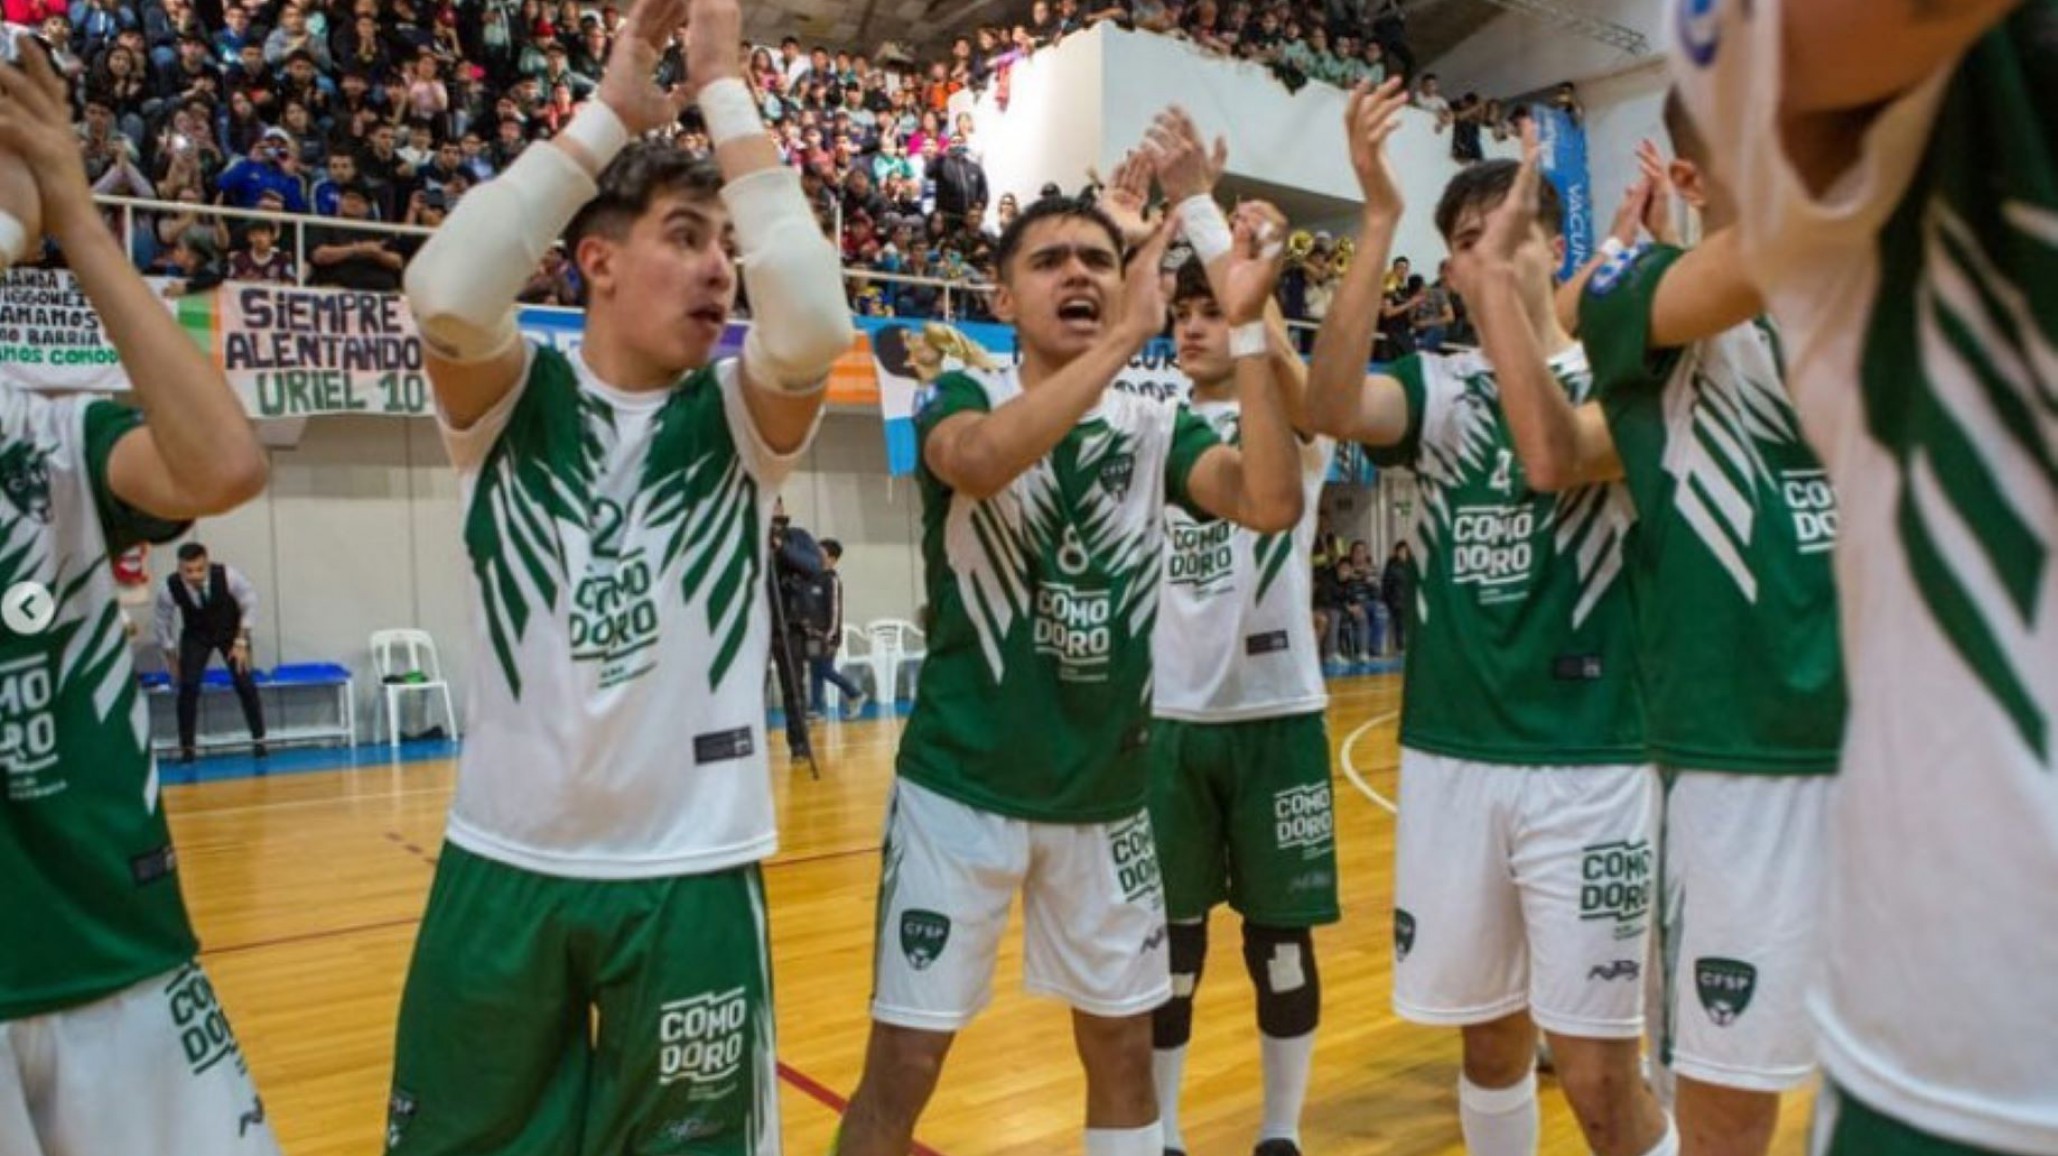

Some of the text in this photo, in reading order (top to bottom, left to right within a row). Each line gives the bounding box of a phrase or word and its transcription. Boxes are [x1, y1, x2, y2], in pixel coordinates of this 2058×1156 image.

[226, 332, 422, 371] ALENTANDO
[256, 368, 425, 415] URIEL 10
[588, 497, 624, 558] 2
[1453, 512, 1534, 545] COMO
[1056, 521, 1091, 575] 8
[1169, 546, 1232, 577] DORO
[1453, 542, 1533, 576] DORO
[568, 599, 658, 648] DORO
[1036, 590, 1110, 628] COMO
[1034, 617, 1110, 656] DORO
[1275, 789, 1331, 818] COMO
[1277, 811, 1333, 841] DORO
[660, 997, 747, 1044] COMO
[660, 1031, 743, 1074] DORO
